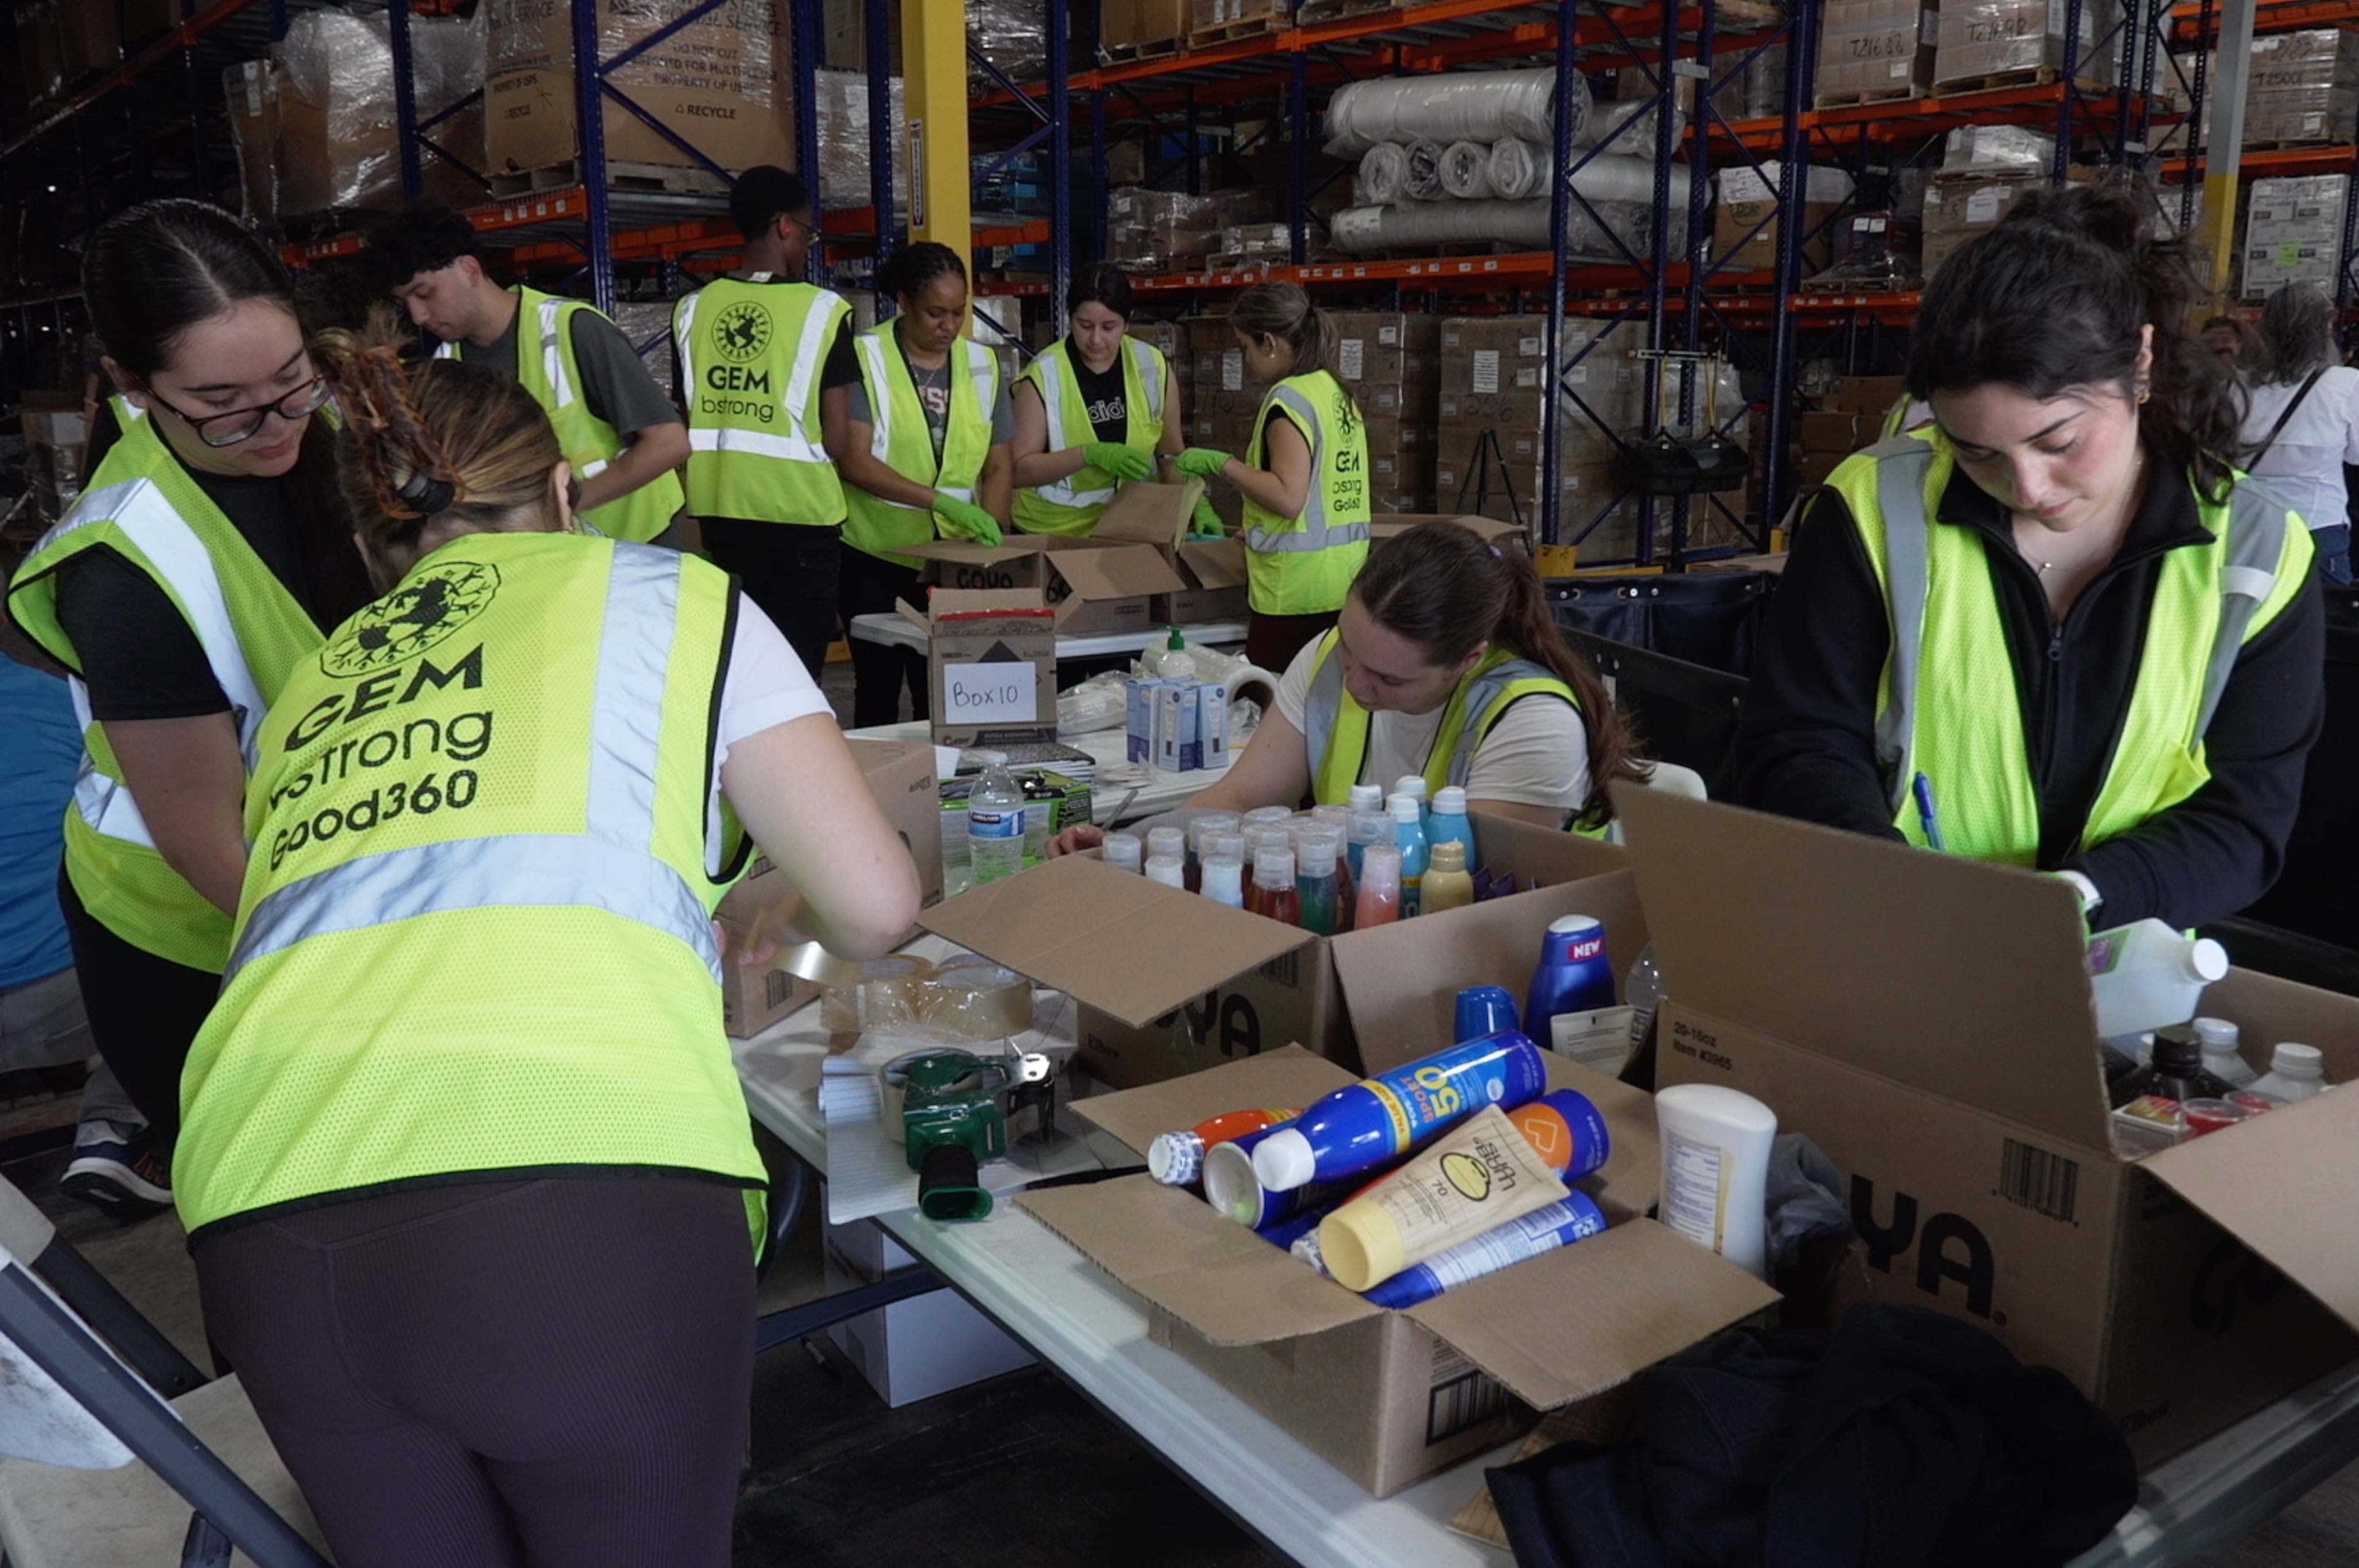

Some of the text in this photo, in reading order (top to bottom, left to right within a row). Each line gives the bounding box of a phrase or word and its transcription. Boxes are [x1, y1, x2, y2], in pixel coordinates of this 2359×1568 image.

[687, 105, 737, 119] RECYCLE
[706, 365, 770, 394] GEM
[702, 396, 774, 424] bstrong
[284, 642, 483, 752] GEM
[270, 769, 478, 872] Good360
[1573, 938, 1602, 959] NEW
[1699, 1048, 1733, 1071] #3965
[1399, 1076, 1435, 1123] SPORT
[1414, 1066, 1461, 1118] 50
[1431, 1179, 1449, 1196] 70
